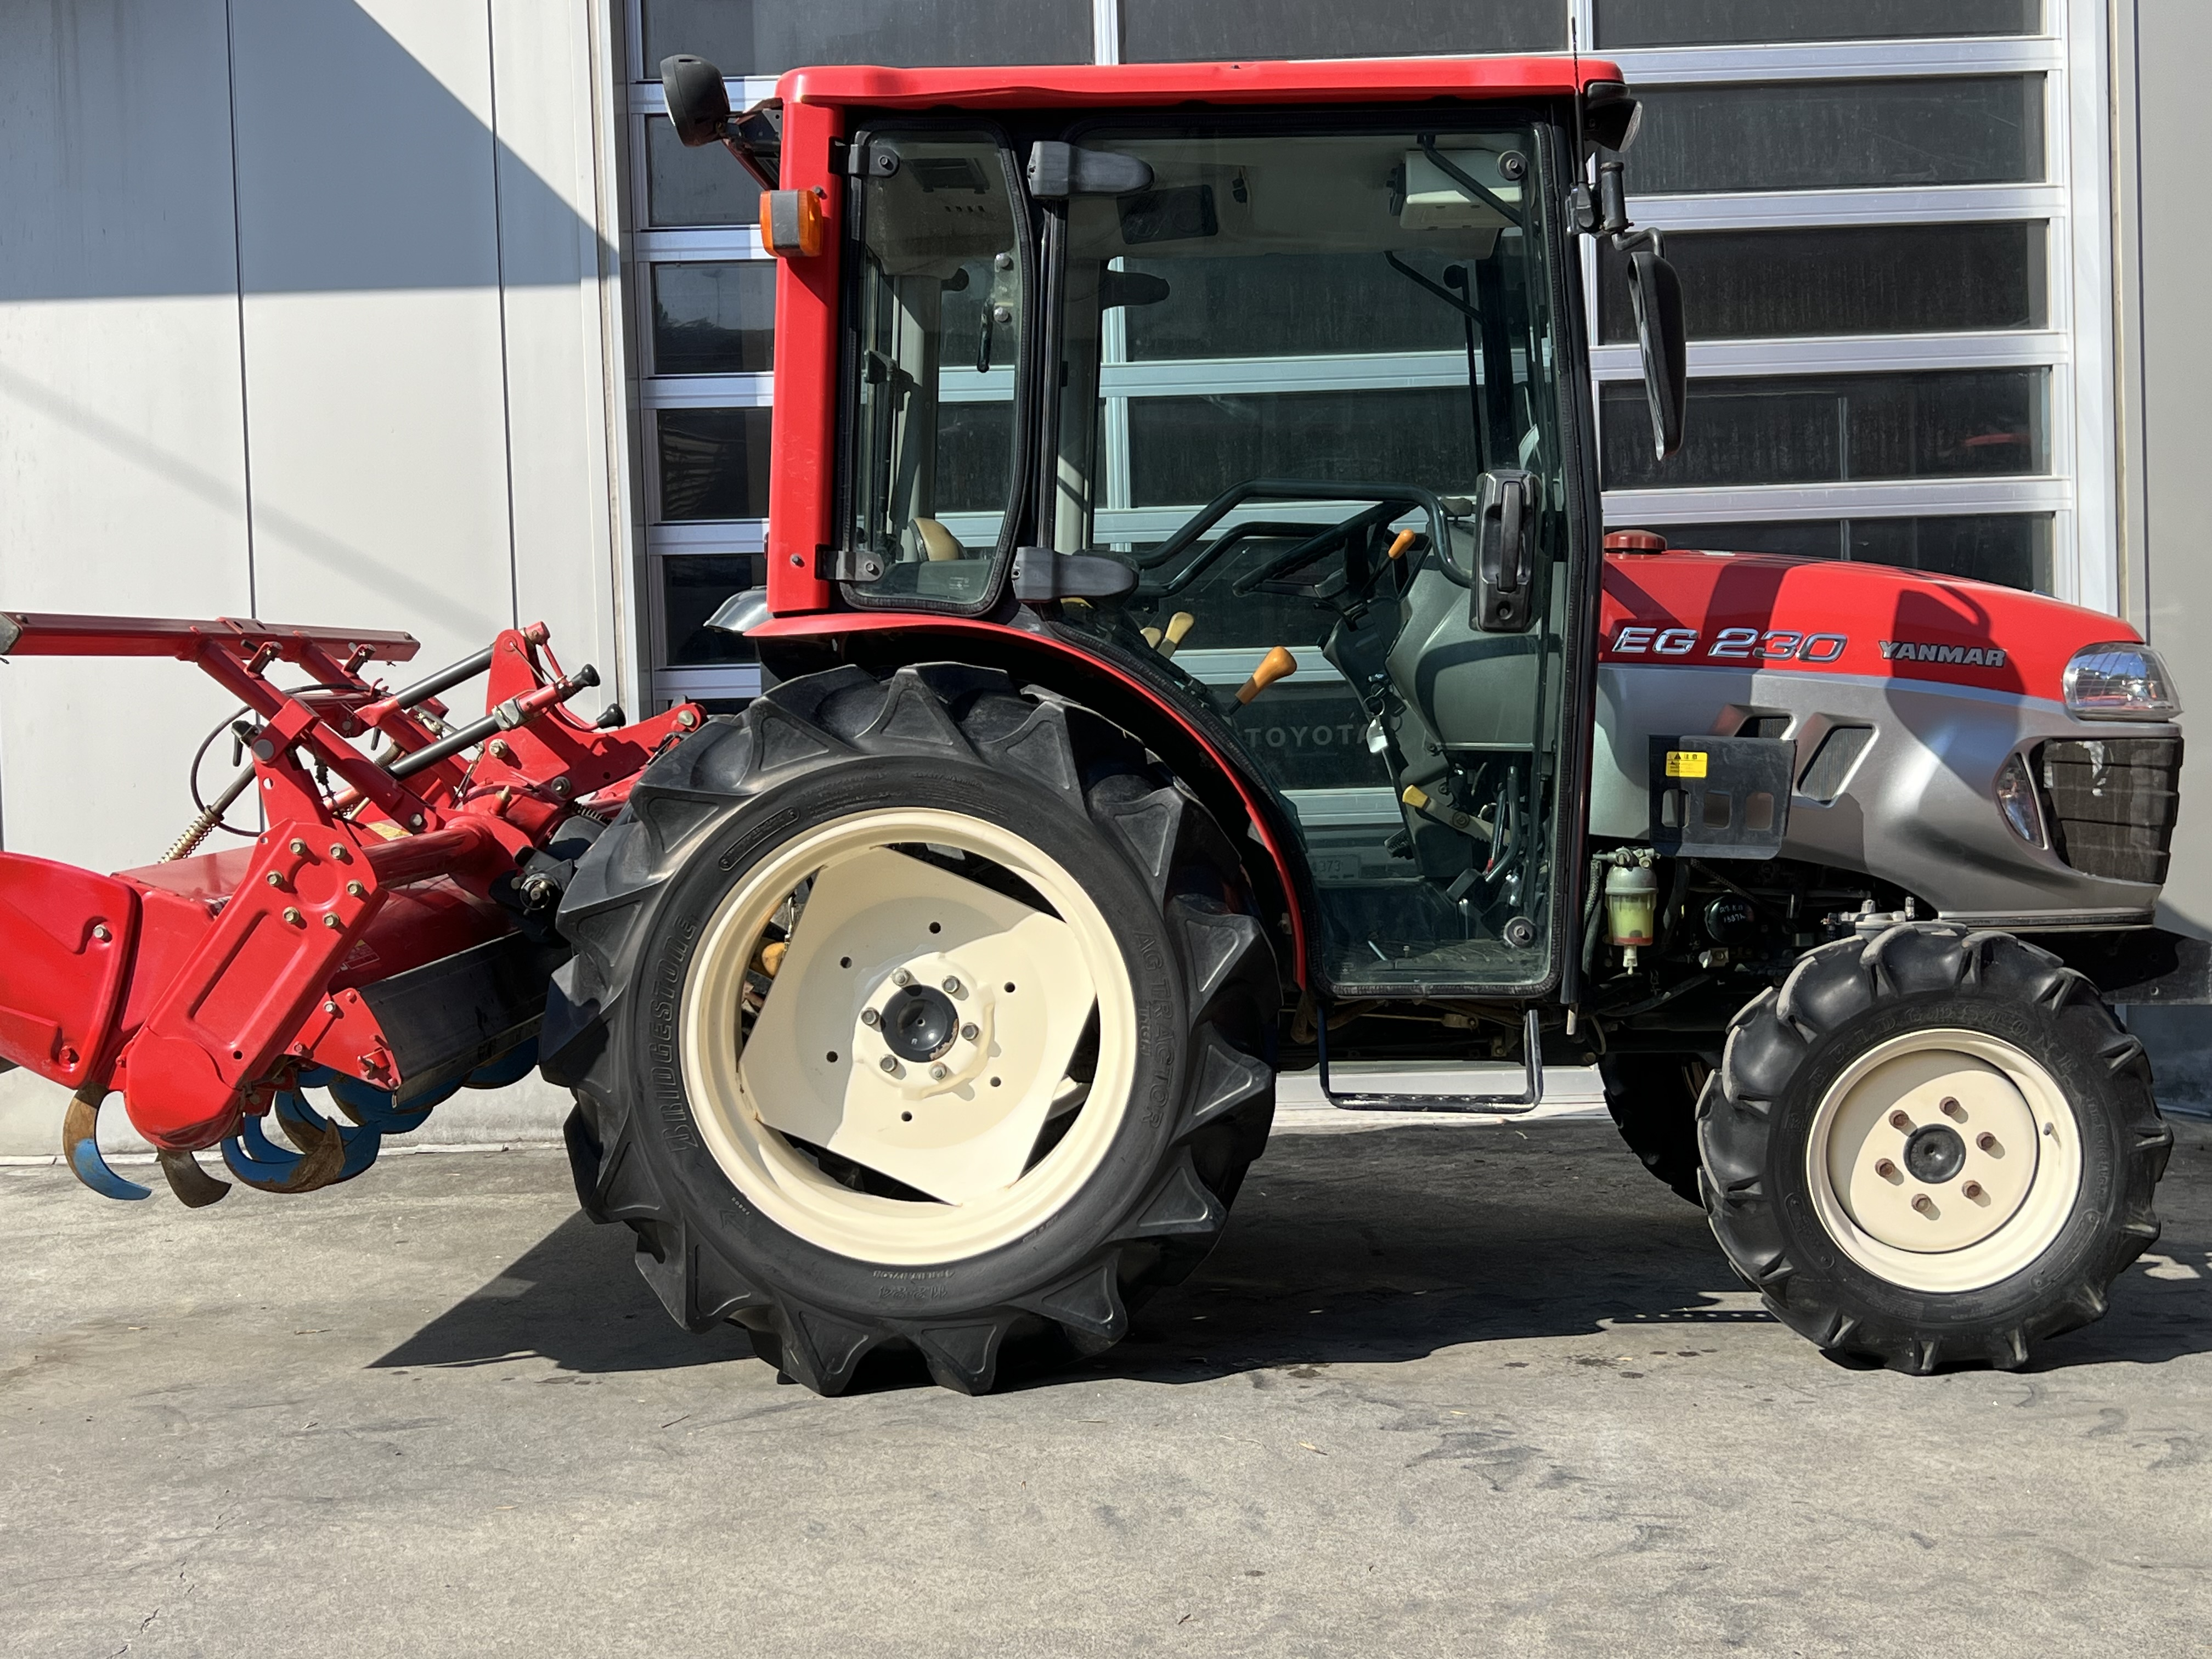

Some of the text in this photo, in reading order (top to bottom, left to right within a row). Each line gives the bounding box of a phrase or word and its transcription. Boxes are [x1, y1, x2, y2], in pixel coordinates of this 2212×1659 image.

[1612, 627, 1848, 663] EG 230
[1878, 640, 2006, 668] YANMAR
[648, 915, 699, 1153] BRIDGESTONE
